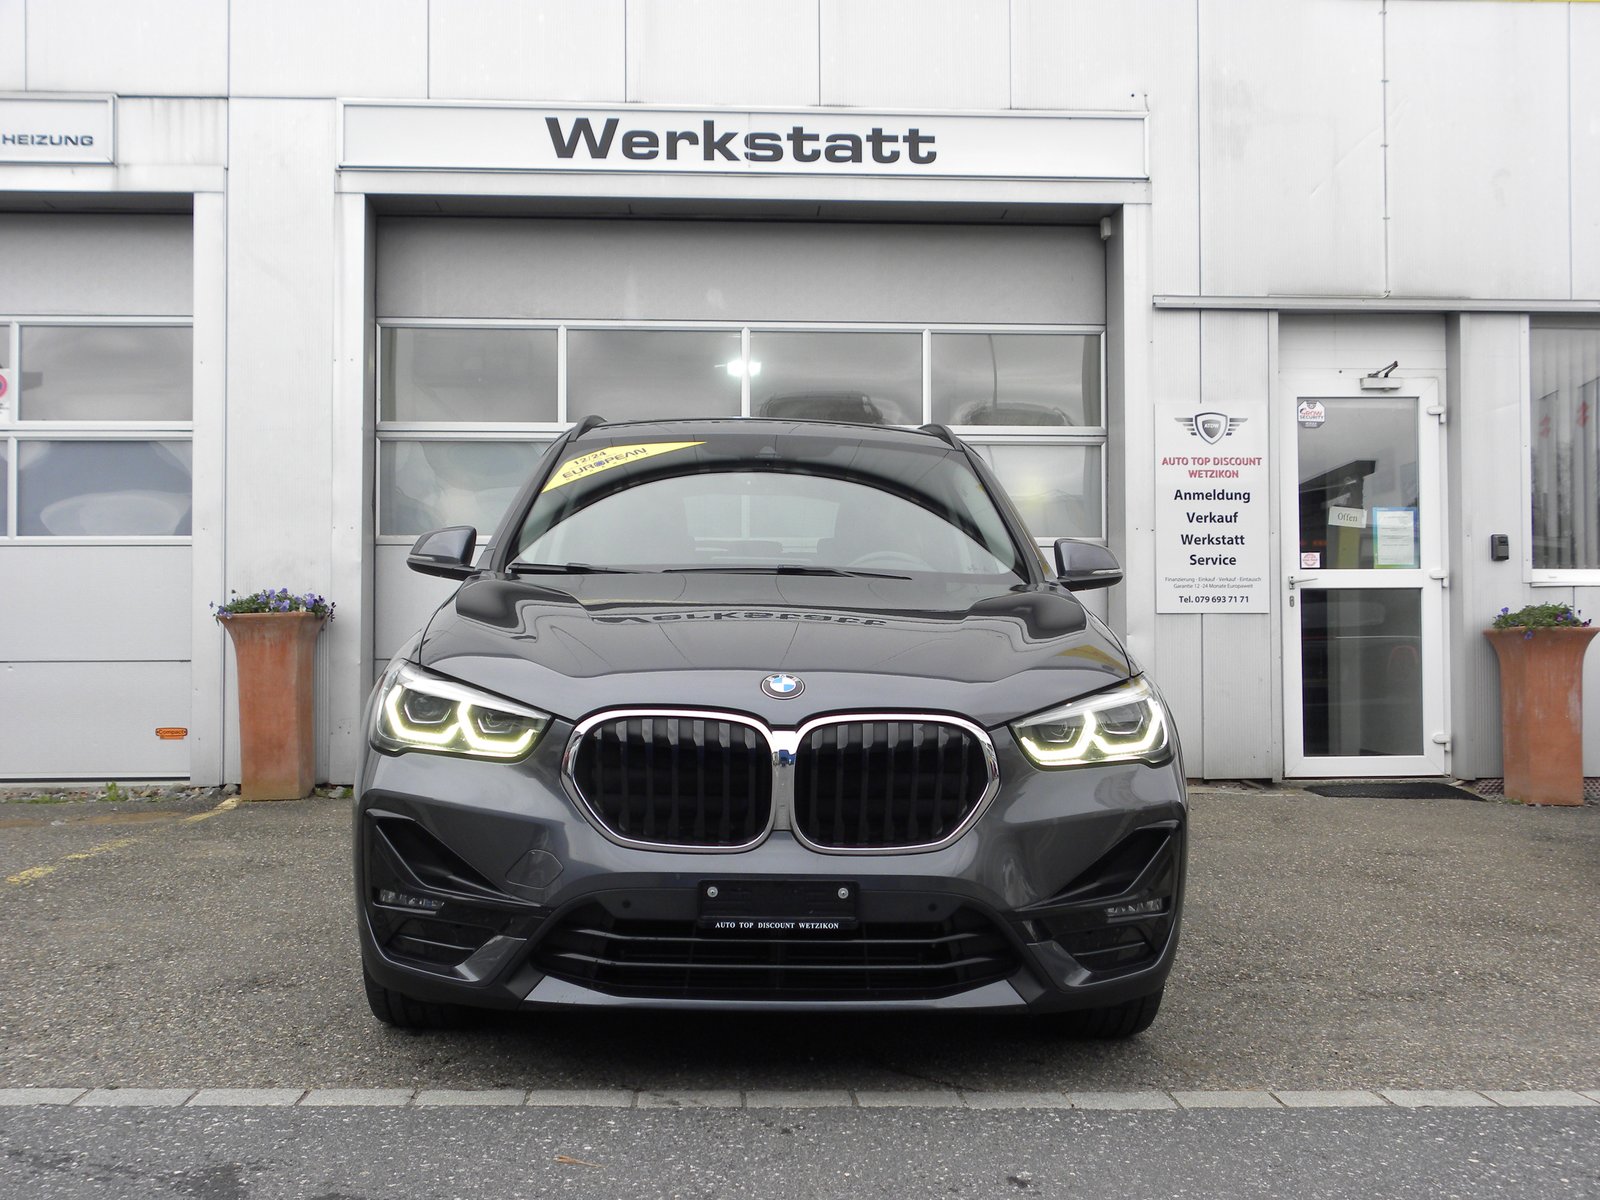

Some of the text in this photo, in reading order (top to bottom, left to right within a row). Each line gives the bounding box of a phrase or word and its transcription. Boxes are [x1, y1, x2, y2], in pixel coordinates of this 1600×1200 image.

[2, 134, 94, 146] HEIZUNG
[544, 116, 937, 164] Werkstatt
[562, 447, 647, 479] EUROPEAN
[573, 451, 607, 465] 12/24
[1162, 457, 1262, 466] AUTO TOP DISCOUNT
[1188, 469, 1239, 478] WETZIKON
[1174, 489, 1251, 503] Anmeldung
[1186, 512, 1239, 523] Verkauf
[1337, 512, 1358, 522] Offen
[1180, 534, 1245, 545] Werkstatt
[1189, 554, 1237, 566] Service
